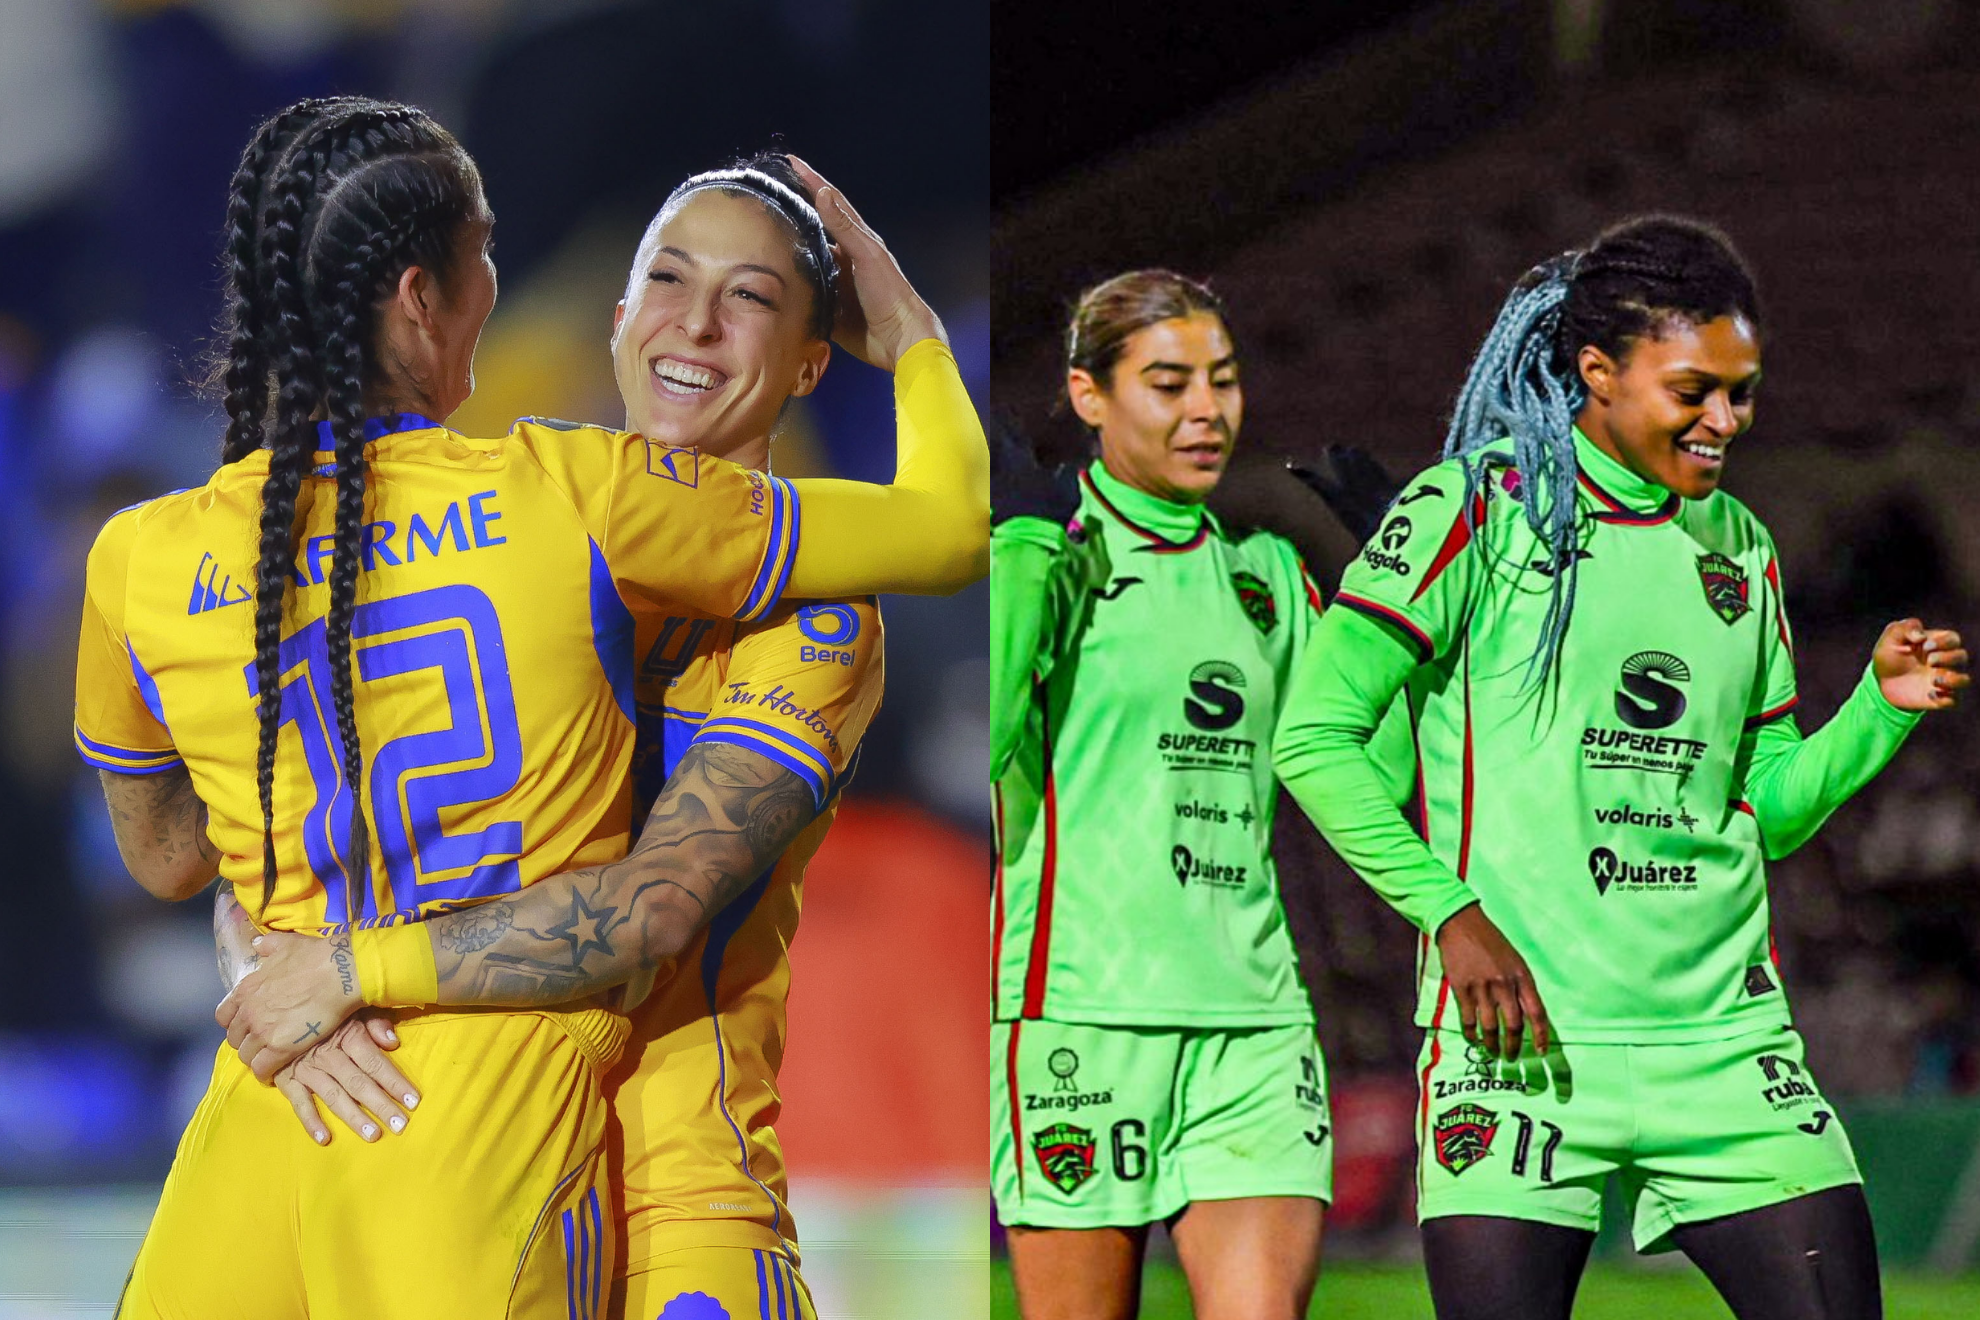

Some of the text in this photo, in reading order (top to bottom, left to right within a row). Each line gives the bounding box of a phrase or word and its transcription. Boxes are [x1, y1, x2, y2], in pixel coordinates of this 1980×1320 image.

[800, 645, 856, 667] Berel
[245, 584, 523, 923] 12
[1581, 727, 1708, 760] SUPERETTE
[1175, 800, 1228, 823] volaris
[1594, 804, 1674, 829] volaris
[1614, 860, 1697, 883] Juárez
[1025, 1090, 1112, 1112] Zaragoza
[1434, 1079, 1528, 1100] Zaragoza
[1111, 1118, 1147, 1182] 6
[1511, 1110, 1564, 1183] 11
